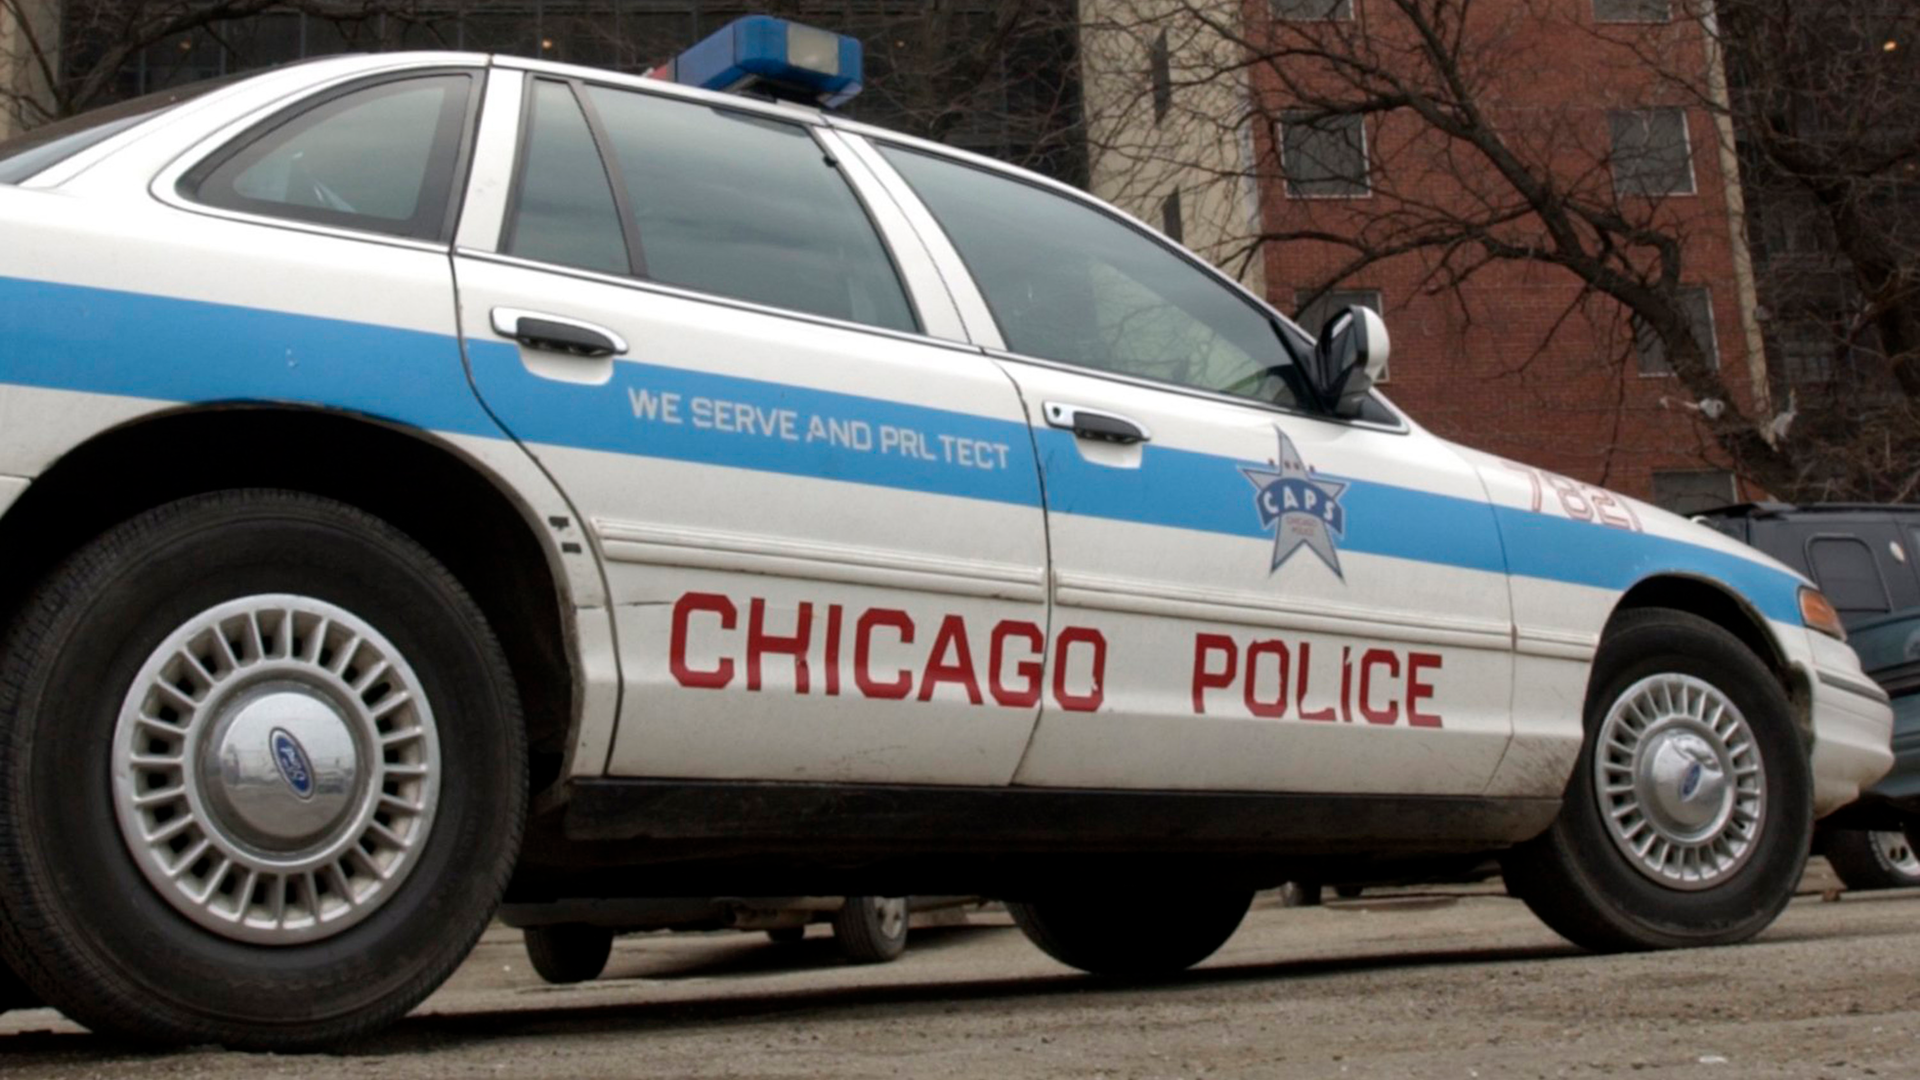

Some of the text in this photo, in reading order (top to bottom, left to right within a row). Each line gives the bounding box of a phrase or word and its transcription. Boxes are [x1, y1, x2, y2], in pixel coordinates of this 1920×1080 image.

[628, 387, 683, 424] WE
[691, 396, 799, 441] SERVE
[805, 415, 872, 451] AND
[1263, 485, 1335, 521] CAPS
[669, 591, 1443, 728] CHICAGO POLICE
